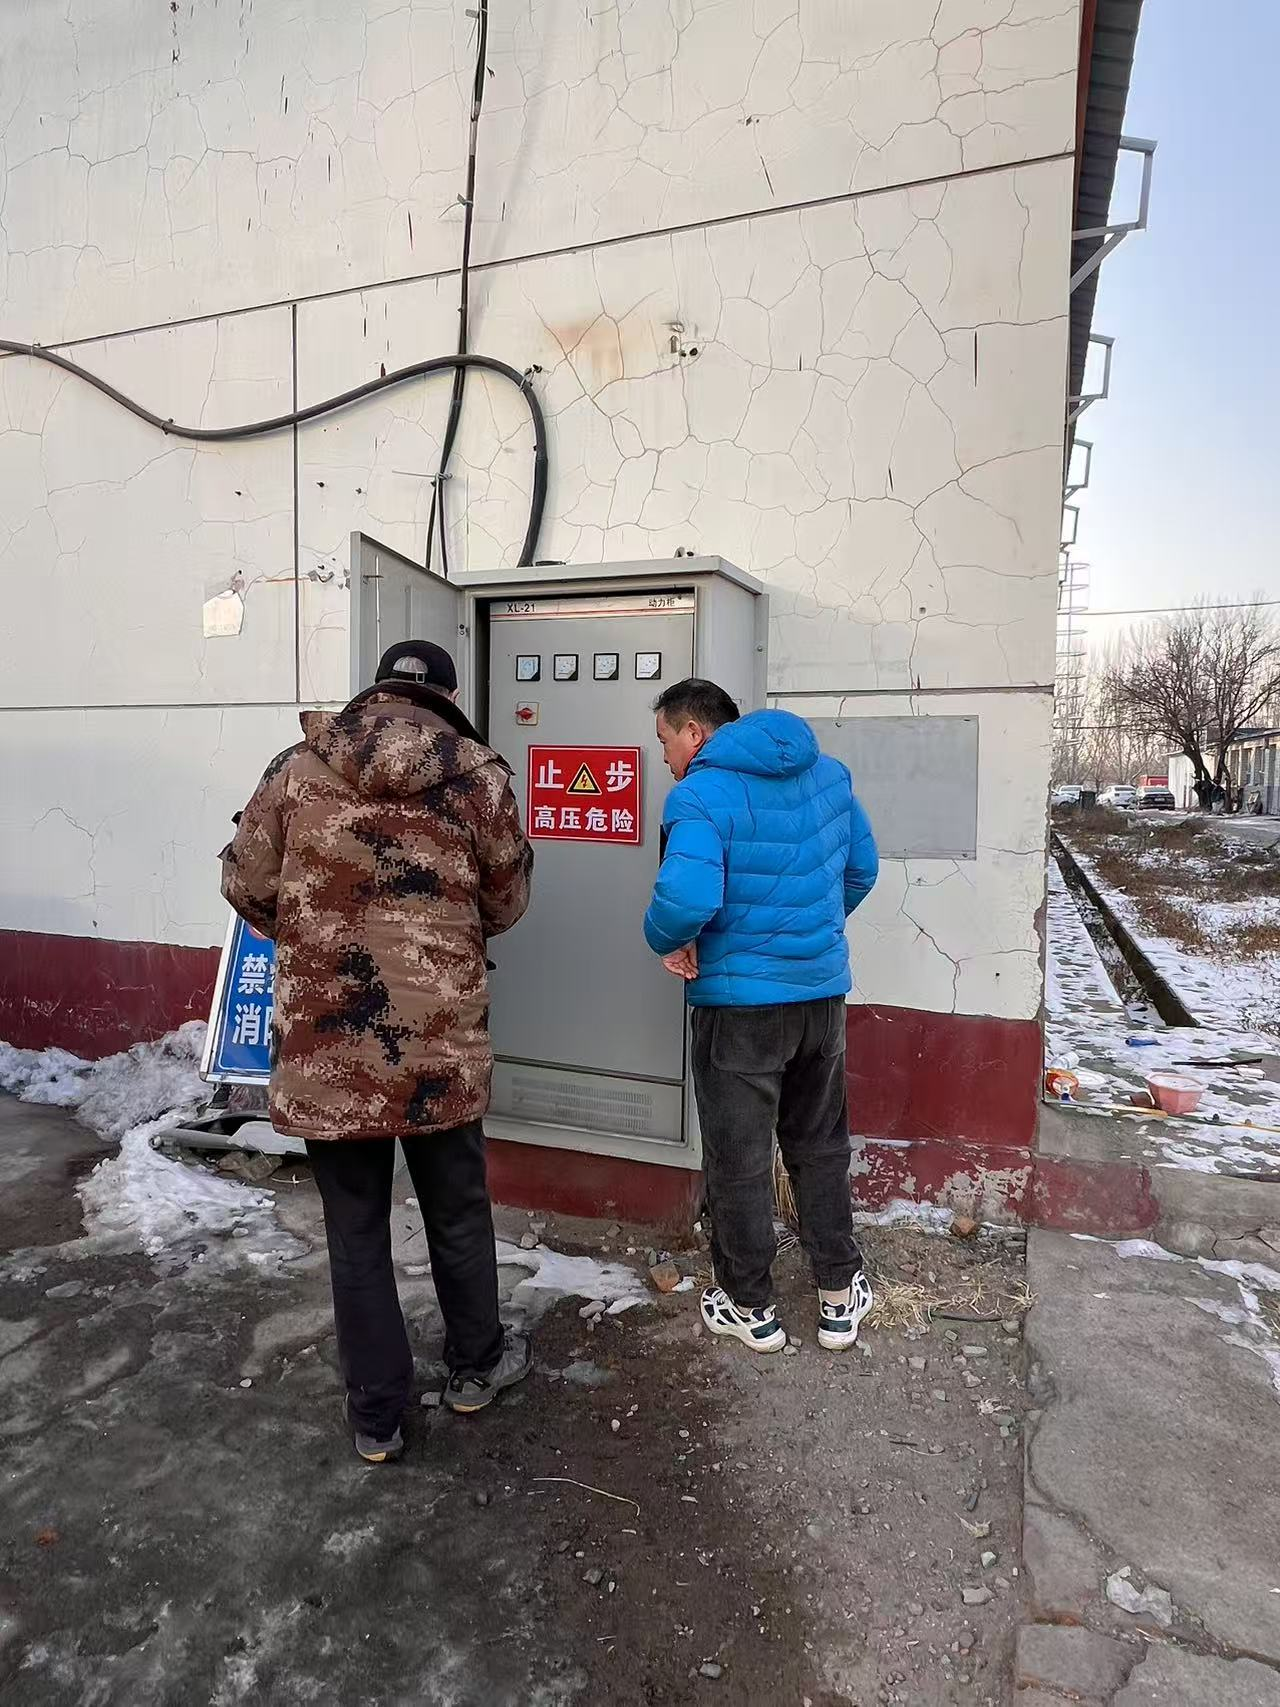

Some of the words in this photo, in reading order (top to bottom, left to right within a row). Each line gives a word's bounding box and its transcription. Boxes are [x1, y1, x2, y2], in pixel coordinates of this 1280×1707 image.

[507, 603, 536, 613] XL-21
[648, 597, 676, 608] 动力柜
[535, 759, 564, 790] 止
[605, 760, 635, 792] 步
[534, 805, 634, 833] 高压危险
